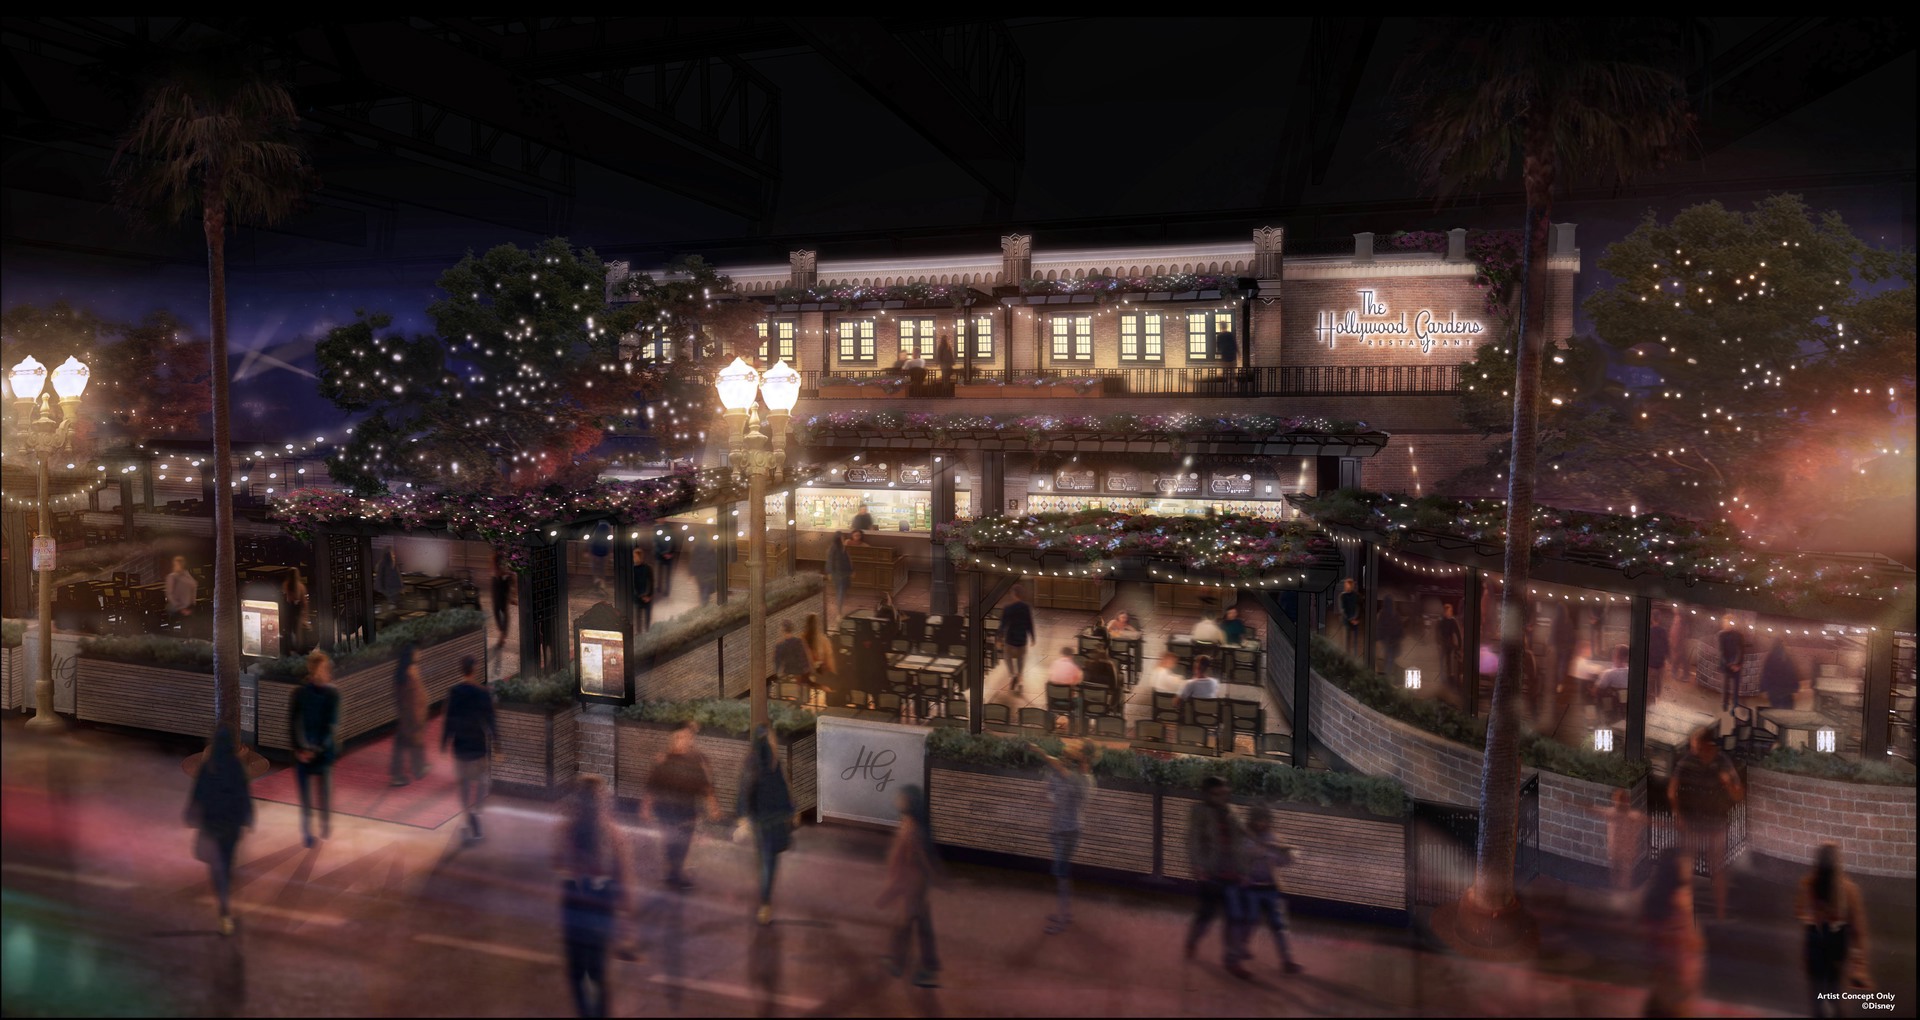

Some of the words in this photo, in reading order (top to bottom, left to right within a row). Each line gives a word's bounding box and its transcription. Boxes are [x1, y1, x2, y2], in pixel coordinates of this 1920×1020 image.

[1357, 290, 1387, 315] The
[1315, 311, 1408, 348] Hollywood
[1414, 310, 1483, 353] Gardens
[840, 744, 897, 792] HG
